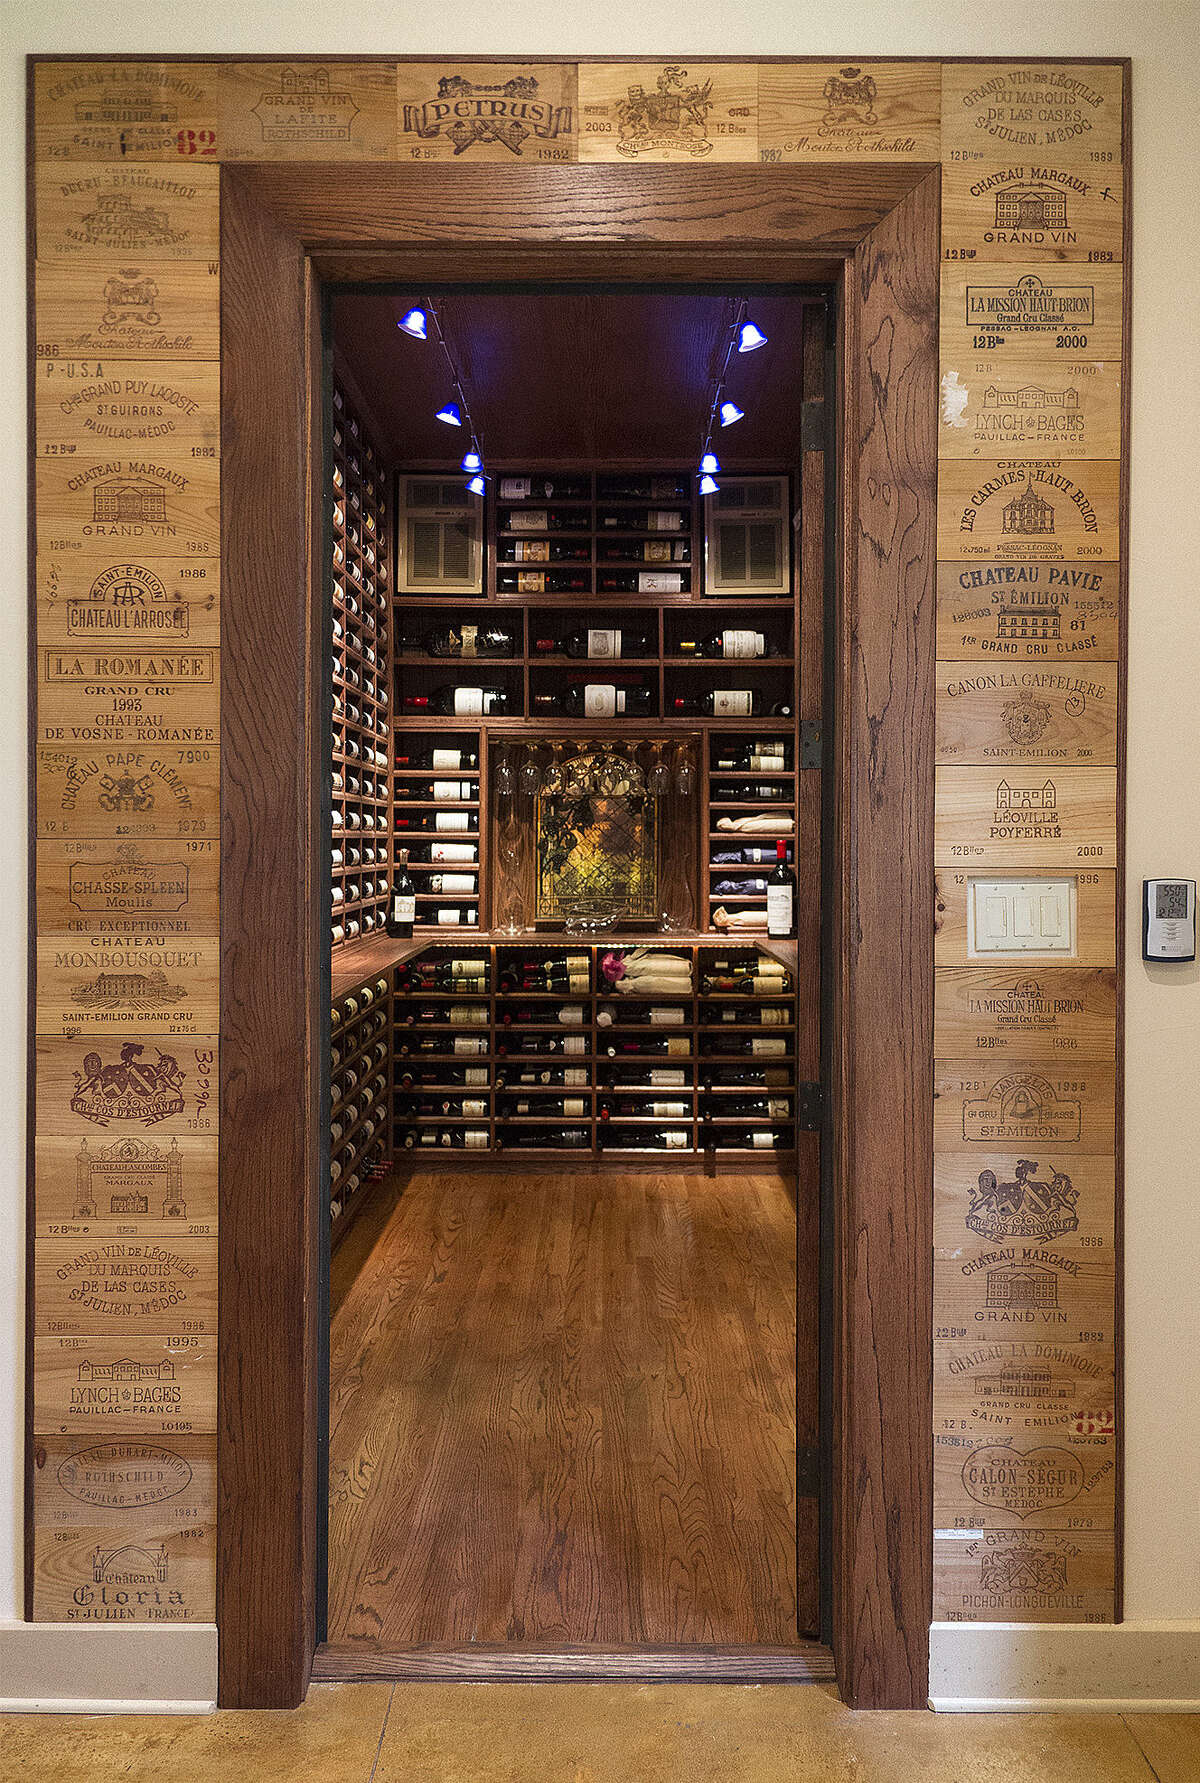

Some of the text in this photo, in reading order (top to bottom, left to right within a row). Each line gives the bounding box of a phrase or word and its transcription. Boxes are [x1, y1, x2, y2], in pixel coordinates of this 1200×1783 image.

[962, 77, 1006, 107] GRAND
[1008, 71, 1031, 84] VIN
[1050, 72, 1104, 108] LÉOVILLE
[265, 96, 347, 105] GRAND VIN
[996, 92, 1076, 105] DU MARQUIS
[431, 100, 543, 121] PETRUS
[988, 108, 1082, 121] DE LAS CASES
[275, 115, 337, 124] LAFITE
[586, 123, 612, 132] 2003
[268, 130, 346, 138] ROTHSCHILD
[177, 130, 217, 155] 82
[536, 150, 569, 160] 1982
[760, 150, 782, 162] 1982
[1090, 152, 1112, 161] 1989
[970, 168, 1092, 196] CHATEAU MARGAUX
[984, 233, 1076, 242] GRAND VIN
[1088, 252, 1113, 261] 1982
[208, 264, 218, 274] W
[971, 298, 984, 312] LA
[988, 298, 1027, 312] MISSION
[997, 313, 1064, 322] Grand Cru Classé
[1056, 336, 1087, 348] 2000
[1067, 367, 1097, 375] 2000
[81, 380, 199, 416] GRAND PUY LACOSTE
[111, 406, 163, 416] GUIRONS
[975, 415, 1084, 430] LYNCH BAGES
[191, 448, 215, 457] 1982
[68, 462, 189, 491] CHATEAU MARGAUX
[961, 470, 1097, 533] LES CARMES HAUT BRION
[83, 526, 176, 536] GRAND VIN
[960, 567, 1103, 591] CHATEAU PAVIE
[71, 609, 120, 627] CHATEAU
[982, 640, 1017, 653] GRAND
[1026, 645, 1047, 654] CRU
[56, 656, 204, 675] LA ROMANÉE
[84, 687, 175, 695] GRAND CRU
[947, 674, 1105, 699] CANON LA GAFFELIERE
[113, 699, 142, 711] 1993
[96, 714, 162, 726] CHATEAU
[46, 728, 64, 739] DE
[61, 753, 192, 810] CHATEAU PAPE CLÉMENT
[994, 810, 1058, 823] LÉOVILLE
[990, 825, 1061, 838] POYFERRÉ
[186, 842, 212, 851] 1971
[1077, 847, 1103, 856] 2000
[103, 867, 155, 880] CHATEAU
[73, 882, 185, 894] CHASSE-SPLEEN
[107, 897, 152, 907] Moulis
[68, 921, 190, 931] CRU EXCEPTIONNEL
[91, 938, 165, 946] CHATEAU
[55, 952, 202, 968] MONBOUSQUET
[970, 1001, 1025, 1013] LA MISSION
[63, 1013, 134, 1021] SAINT-EMILION
[138, 1013, 170, 1021] GRAND
[97, 1105, 114, 1116] COS
[997, 1127, 1059, 1136] EMILION
[991, 1222, 1007, 1232] COS
[57, 1245, 199, 1280] GRAND VIN DE LÉOVILLE
[962, 1249, 1082, 1277] CHATEAU MARGAUX
[88, 1264, 171, 1276] DU MARQUIS
[81, 1281, 176, 1293] DE LAS CASES
[975, 1312, 1067, 1322] GRAND VIN
[166, 1337, 199, 1347] 1995
[949, 1344, 1103, 1378] CHATEAU LA DOMINIQUE
[70, 1387, 181, 1403] LYNCH BAGES
[971, 1409, 1078, 1426] SAINT EMILION
[86, 1472, 164, 1482] ROTHSCHILD
[987, 1531, 1081, 1558] GRAND VIN
[106, 1572, 155, 1584] Château
[74, 1585, 184, 1605] Gloria
[963, 1596, 1083, 1609] PICHON-LONGUEVILLE
[83, 1609, 135, 1618] JULIEN
